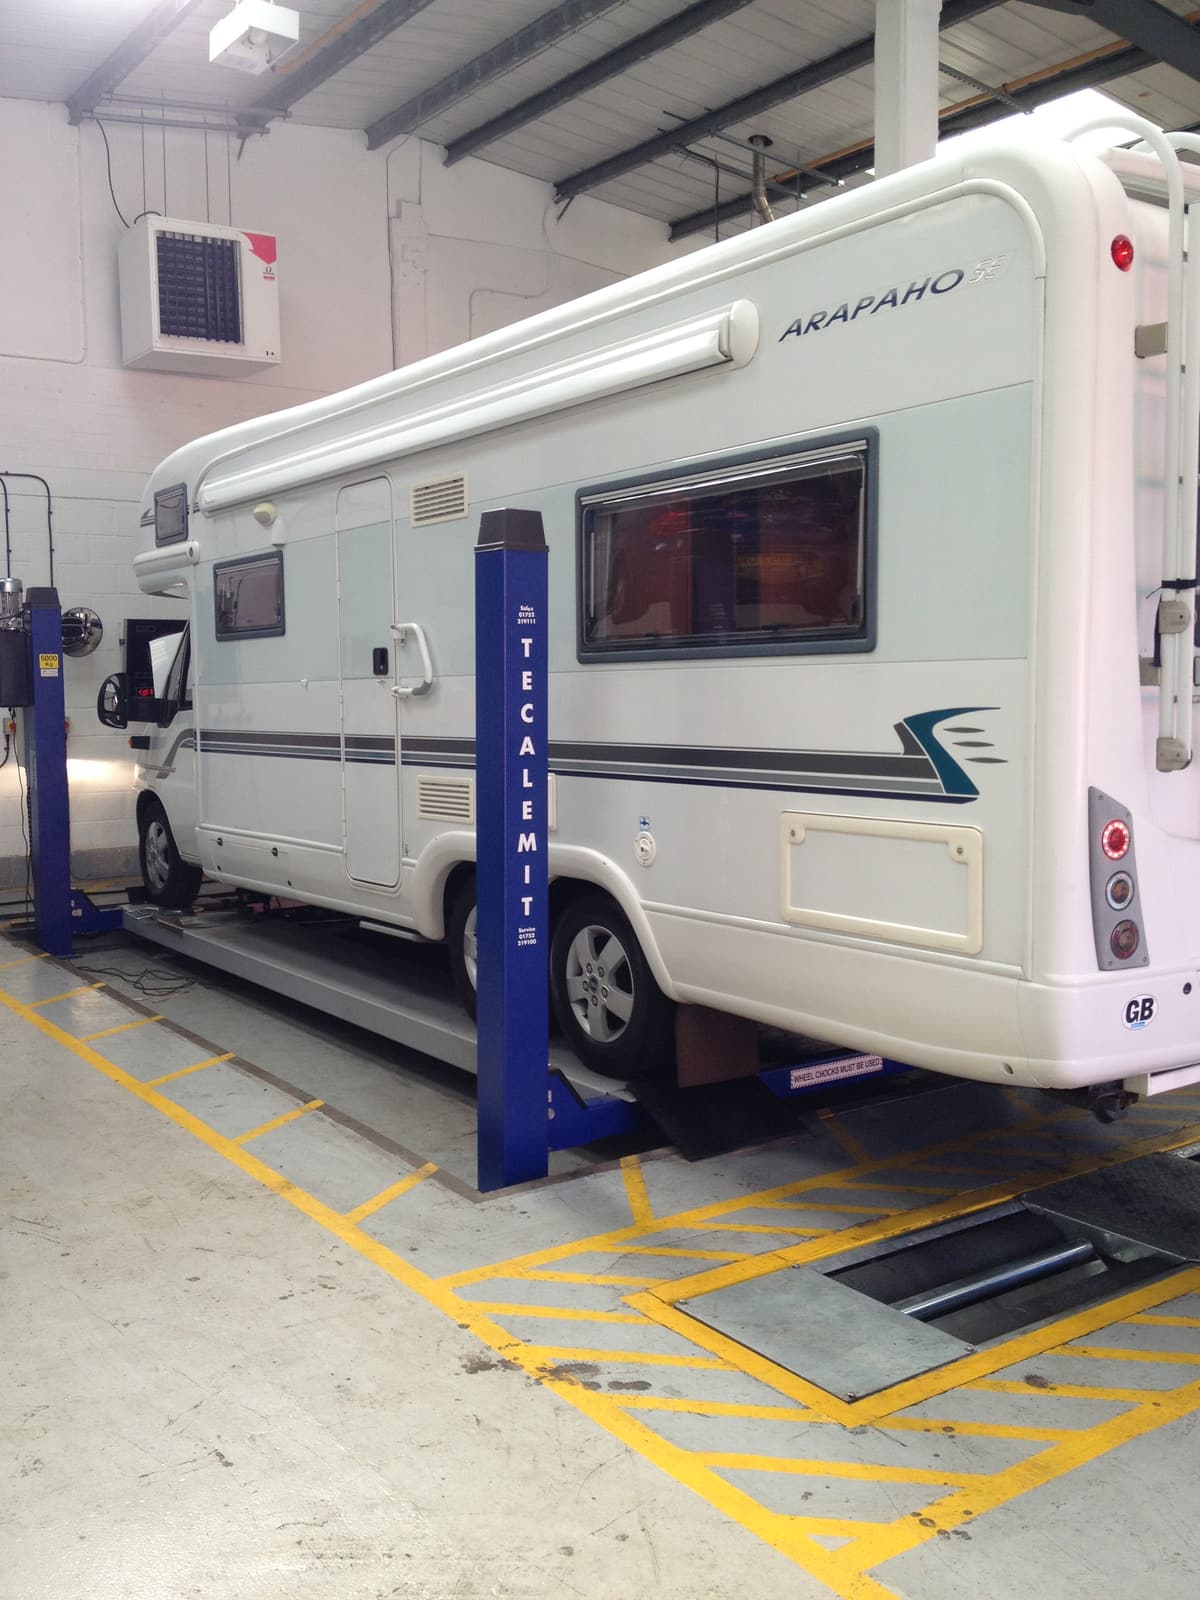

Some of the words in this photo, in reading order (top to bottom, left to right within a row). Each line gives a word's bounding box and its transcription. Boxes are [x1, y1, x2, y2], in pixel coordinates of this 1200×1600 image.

[778, 269, 964, 342] ARAPAHO
[968, 255, 1006, 284] SE
[517, 638, 537, 916] TECALEMIT
[1125, 998, 1154, 1023] GB
[794, 1072, 814, 1084] WHEEL
[815, 1067, 840, 1079] CHOCKS
[840, 1063, 855, 1073] MUST
[856, 1061, 864, 1070] BE
